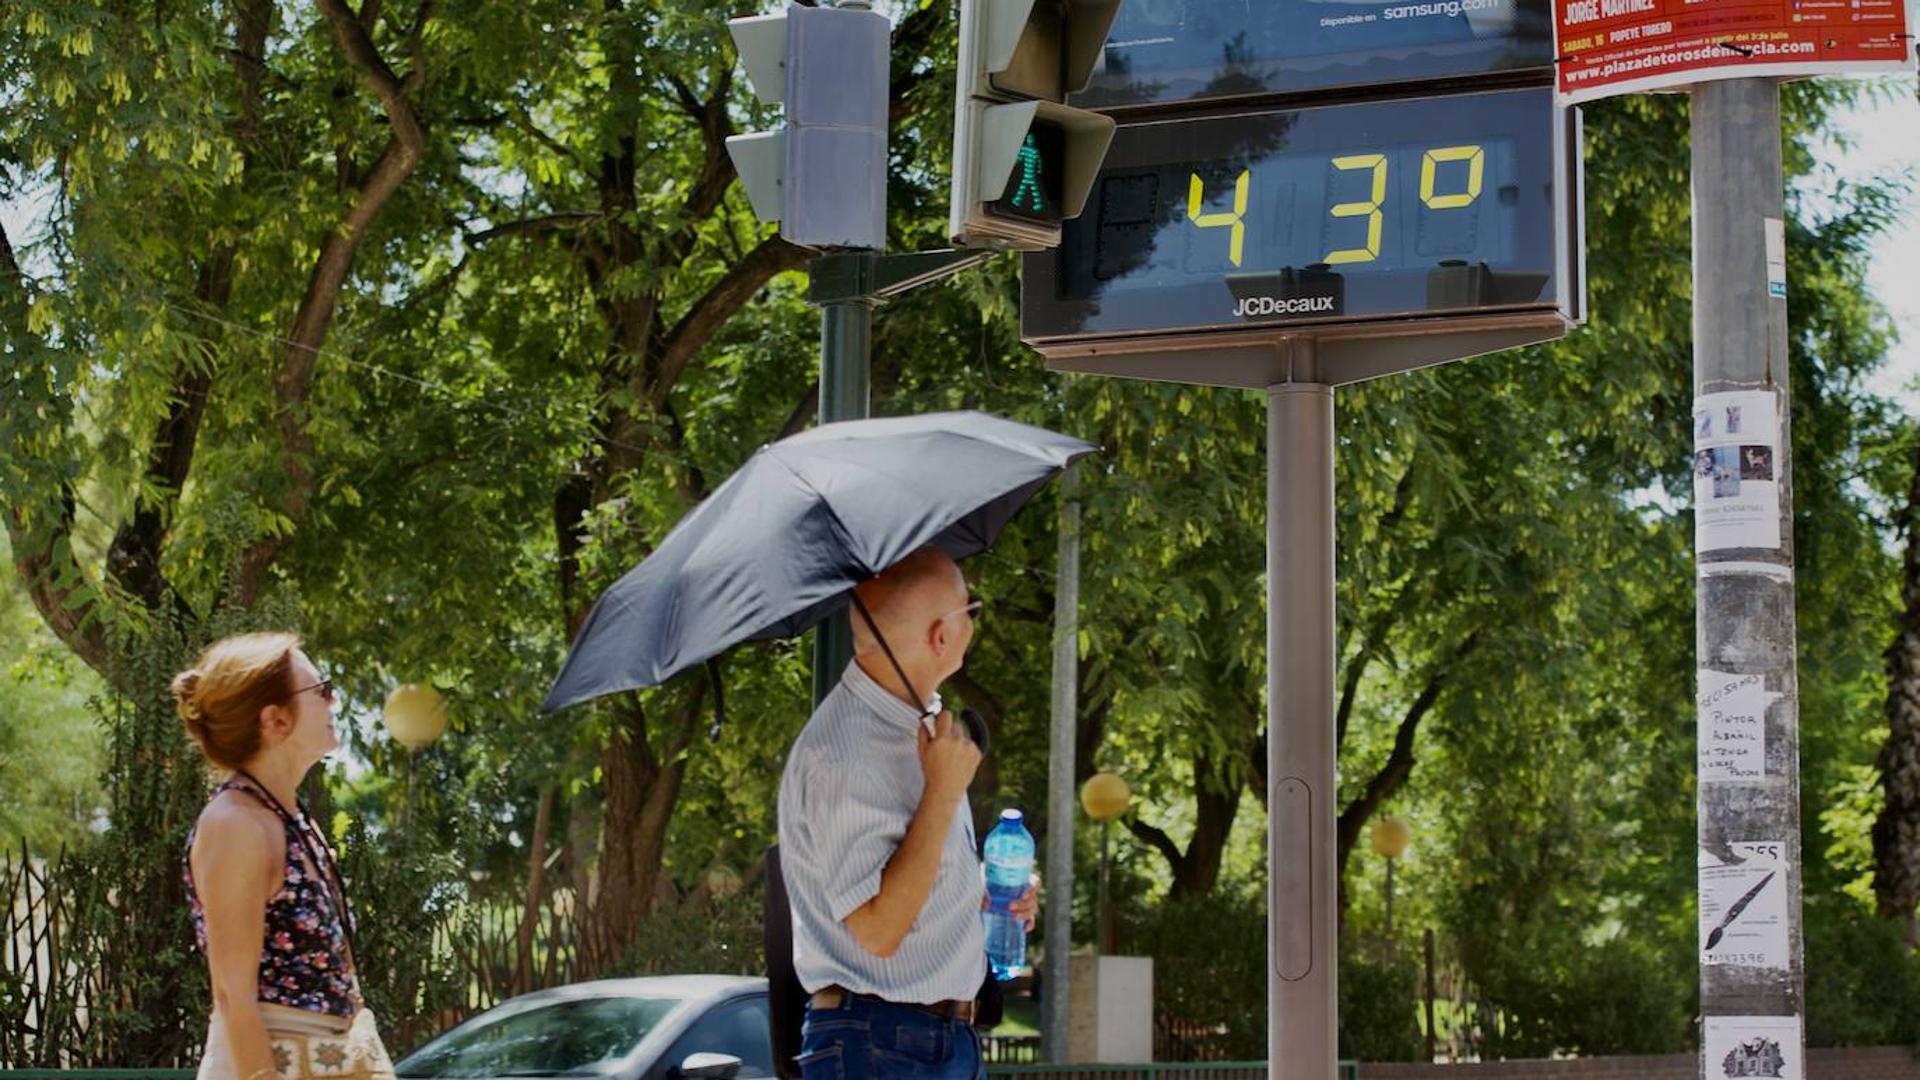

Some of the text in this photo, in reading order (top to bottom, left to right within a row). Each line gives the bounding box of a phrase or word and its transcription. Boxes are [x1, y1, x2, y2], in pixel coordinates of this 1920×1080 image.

[1320, 0, 1499, 27] Disponible en samsung.com
[1564, 0, 1600, 25] JORGE
[1610, 26, 1640, 43] POPEYE
[1641, 21, 1672, 37] TORERO
[1233, 295, 1334, 318] JCDecaux
